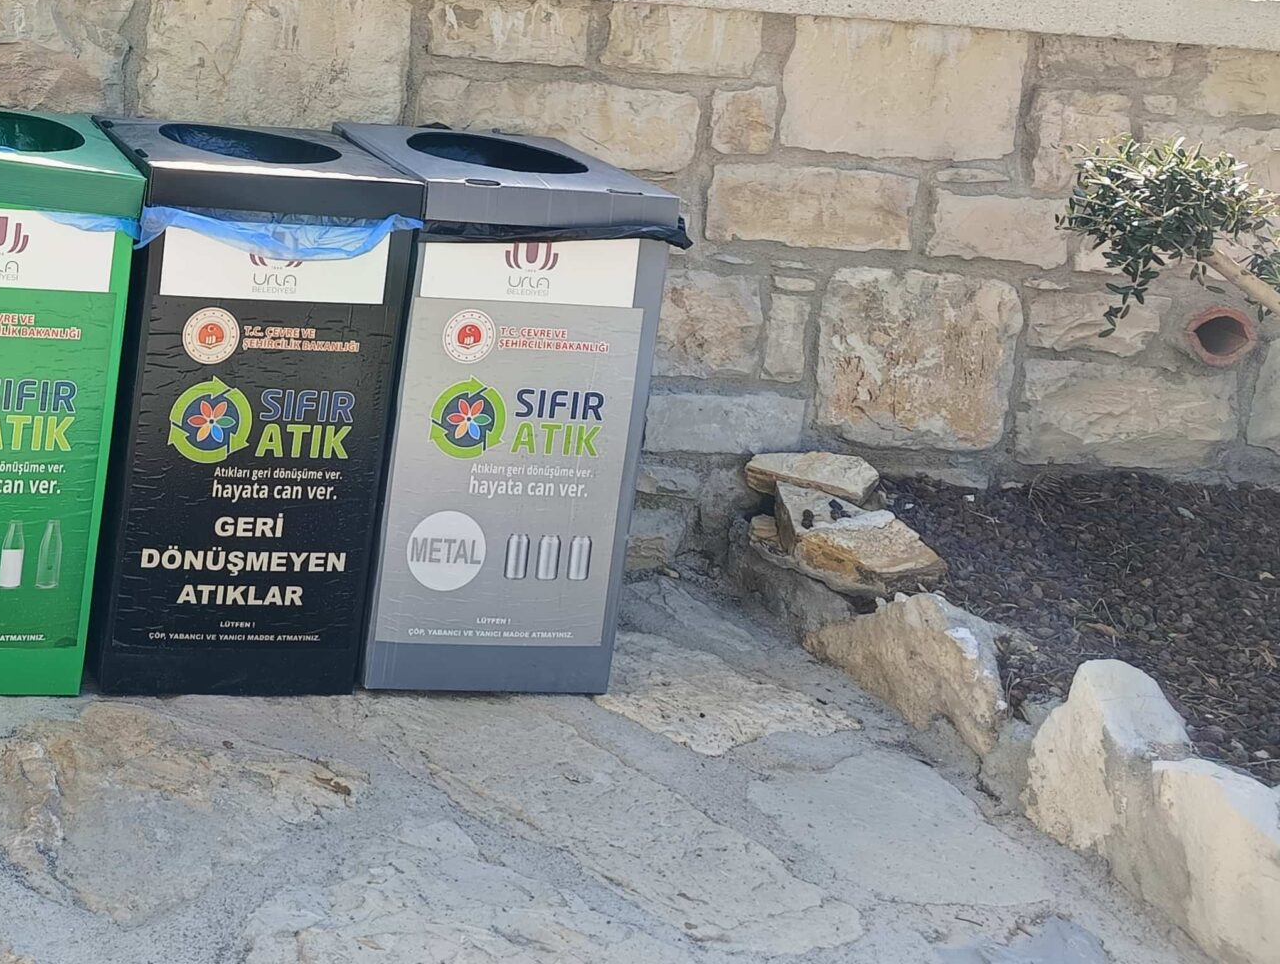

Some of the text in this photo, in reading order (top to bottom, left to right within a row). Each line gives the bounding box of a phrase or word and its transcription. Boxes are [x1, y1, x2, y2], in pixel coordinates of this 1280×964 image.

[19, 314, 35, 324] VE
[244, 326, 264, 337] T.C.
[300, 328, 316, 338] VE
[500, 327, 519, 337] T.C.
[554, 329, 567, 339] VE
[259, 388, 356, 423] SIFIR
[515, 389, 605, 421] SIFIR
[255, 423, 352, 460] ATIK
[510, 421, 602, 457] ATIK
[48, 464, 66, 473] ver.
[214, 467, 343, 481] Atıkları geri dönüşüme ver.
[471, 463, 593, 479] Atıkları geri dönüşüme ver.
[29, 479, 61, 494] ver.
[212, 480, 338, 503] hayata can ver.
[469, 477, 588, 498] hayata can ver.
[214, 513, 284, 538] GERİ
[140, 545, 347, 576] DÖNÜŞMEYEN
[410, 536, 482, 565] METAL
[176, 584, 303, 606] ATIKLAR
[220, 620, 251, 628] LÜTFEN
